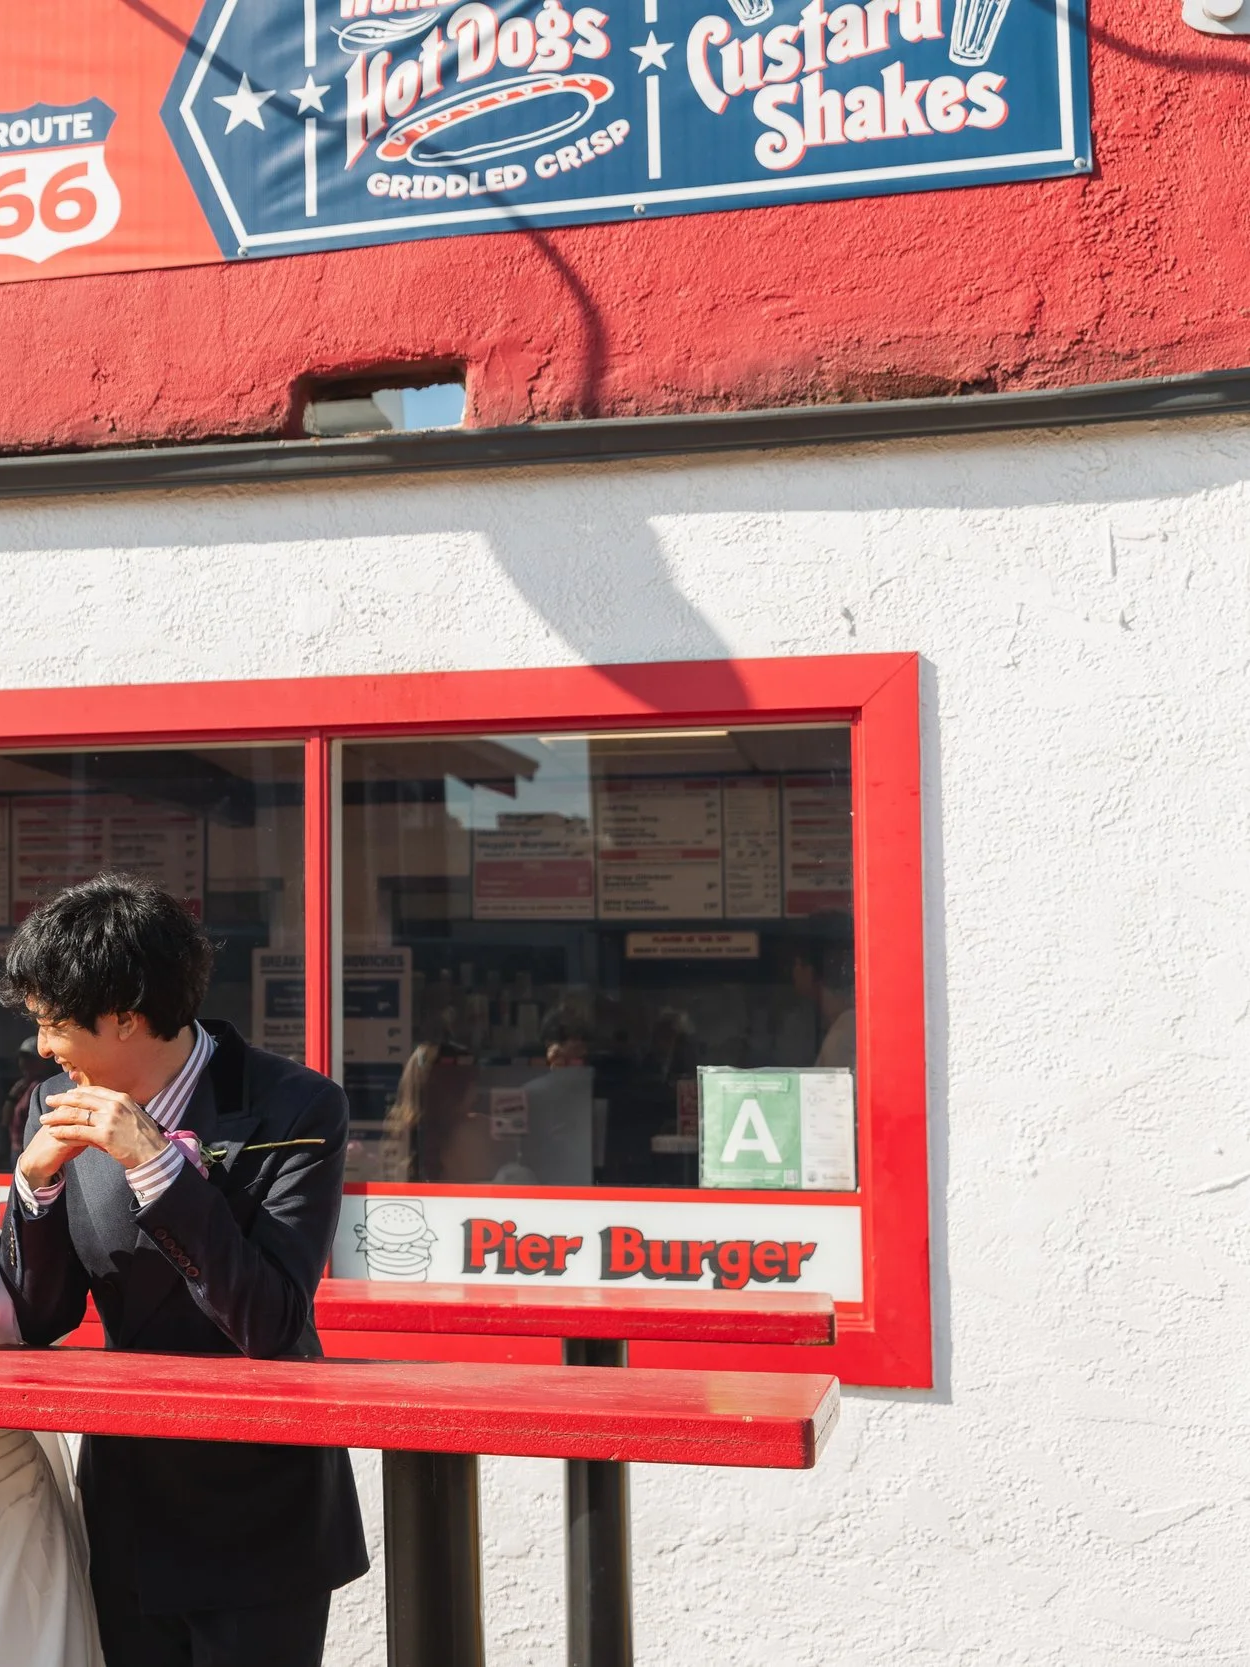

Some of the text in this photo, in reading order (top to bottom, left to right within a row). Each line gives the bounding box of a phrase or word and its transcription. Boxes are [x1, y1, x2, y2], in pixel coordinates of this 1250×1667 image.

[344, 0, 611, 170] Hot Dogs
[753, 60, 1009, 172] Shakes
[366, 118, 631, 200] GRIDDLED CRISP
[719, 1098, 783, 1164] A
[461, 1218, 817, 1289] Pier Burger
